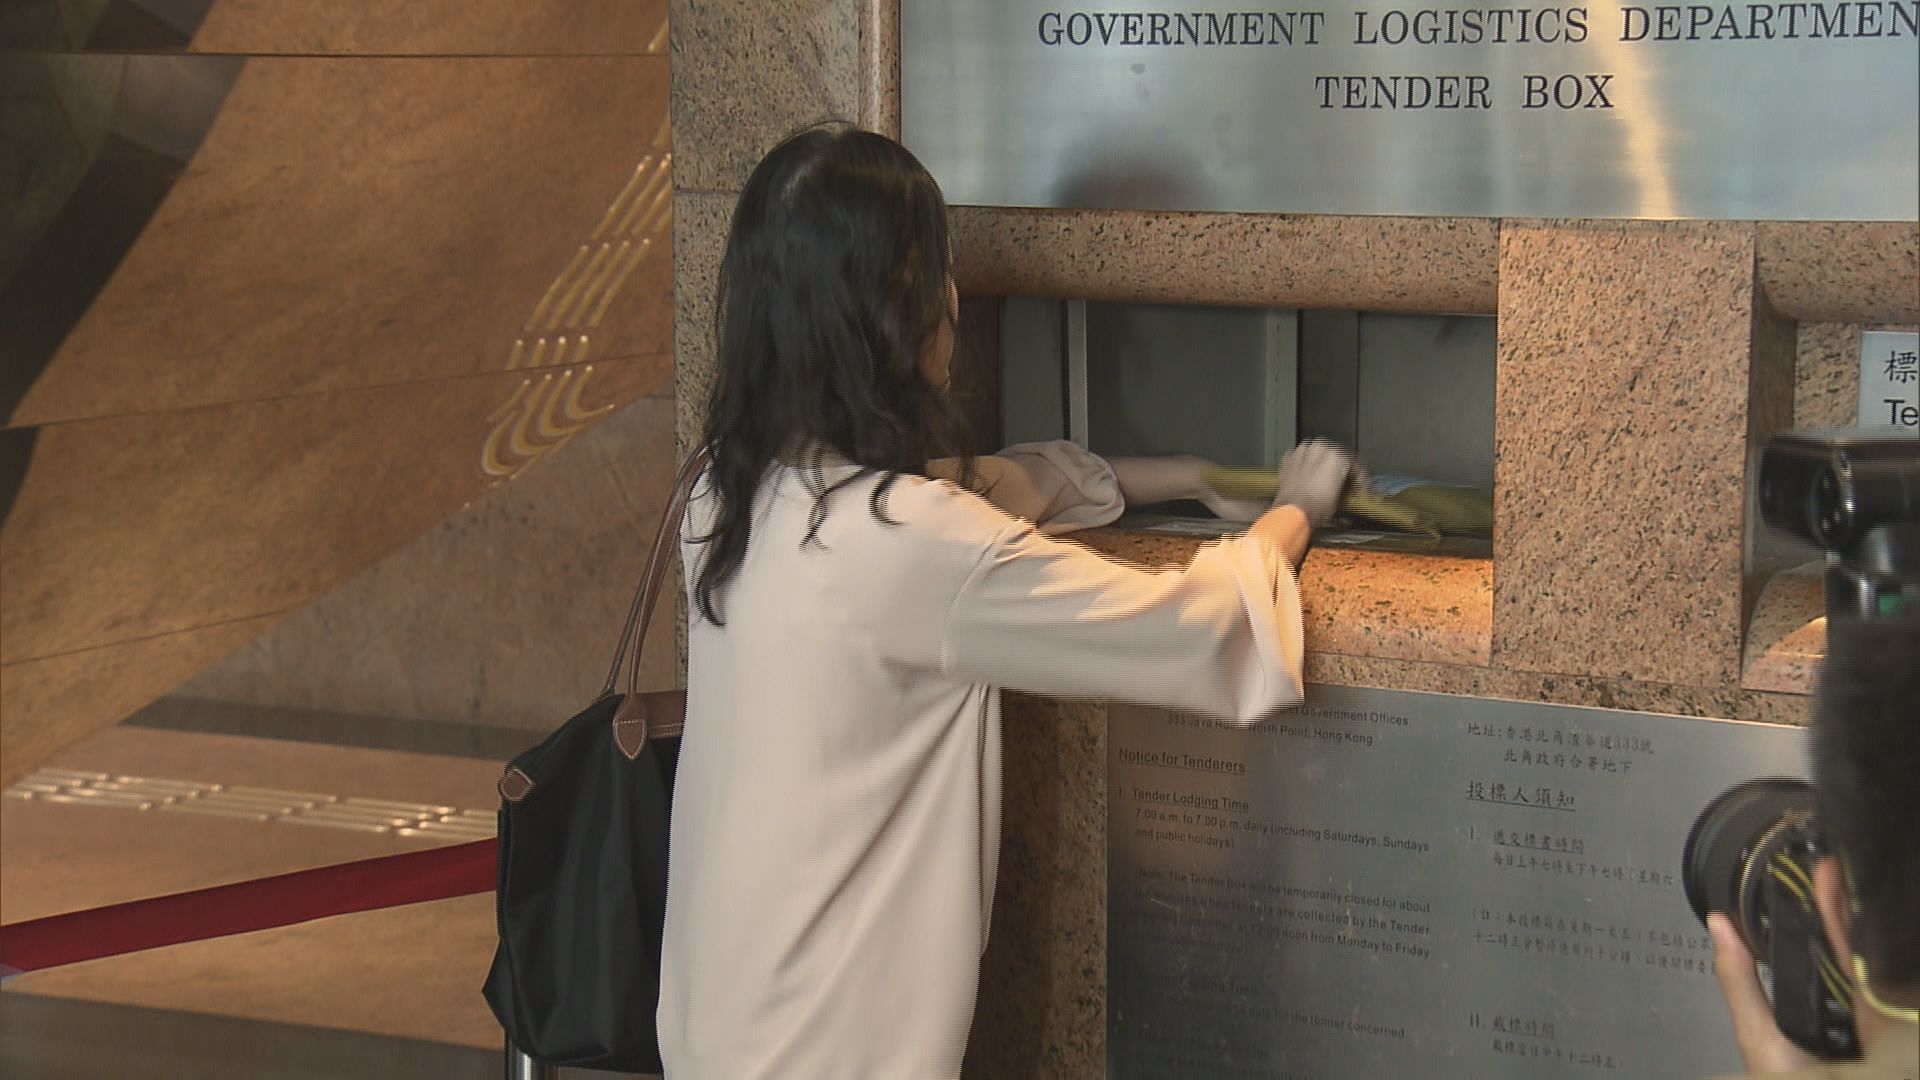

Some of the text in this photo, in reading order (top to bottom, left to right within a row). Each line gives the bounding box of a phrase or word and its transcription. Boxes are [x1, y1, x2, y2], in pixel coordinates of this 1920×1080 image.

[1037, 11, 1326, 47] GOVERNMENT
[1353, 7, 1589, 46] LOGISTICS
[1314, 74, 1615, 110] TENDER BOX
[1883, 350, 1918, 384] 標
[1883, 398, 1919, 426] Te
[1301, 704, 1367, 722] Government
[1369, 711, 1409, 727] Offices
[1313, 728, 1341, 744] Hong
[1344, 732, 1374, 747] Kong
[1119, 748, 1245, 774] Notice for Tenderers
[1133, 787, 1171, 803] Tender
[1172, 793, 1218, 811] Lodging
[1220, 797, 1249, 812] Time
[1465, 780, 1576, 807] 投標人須知
[1155, 831, 1186, 844] public
[1182, 814, 1193, 825] to
[1243, 821, 1268, 836] daily
[1270, 824, 1320, 843] (including
[1383, 835, 1430, 854] Sundays
[1189, 872, 1225, 889] Tender
[1282, 886, 1342, 904] temporarily
[1344, 893, 1380, 908] closed
[1381, 896, 1397, 909] for
[1399, 900, 1431, 914] about
[1275, 907, 1295, 918] are
[1297, 909, 1349, 926] collected
[1350, 914, 1366, 930] by
[1367, 916, 1388, 930] the
[1389, 919, 1430, 937] Tender
[1281, 929, 1308, 943] noon
[1310, 930, 1336, 946] from
[1336, 934, 1379, 954] Monday
[1381, 940, 1394, 952] to
[1394, 942, 1430, 961] Friday
